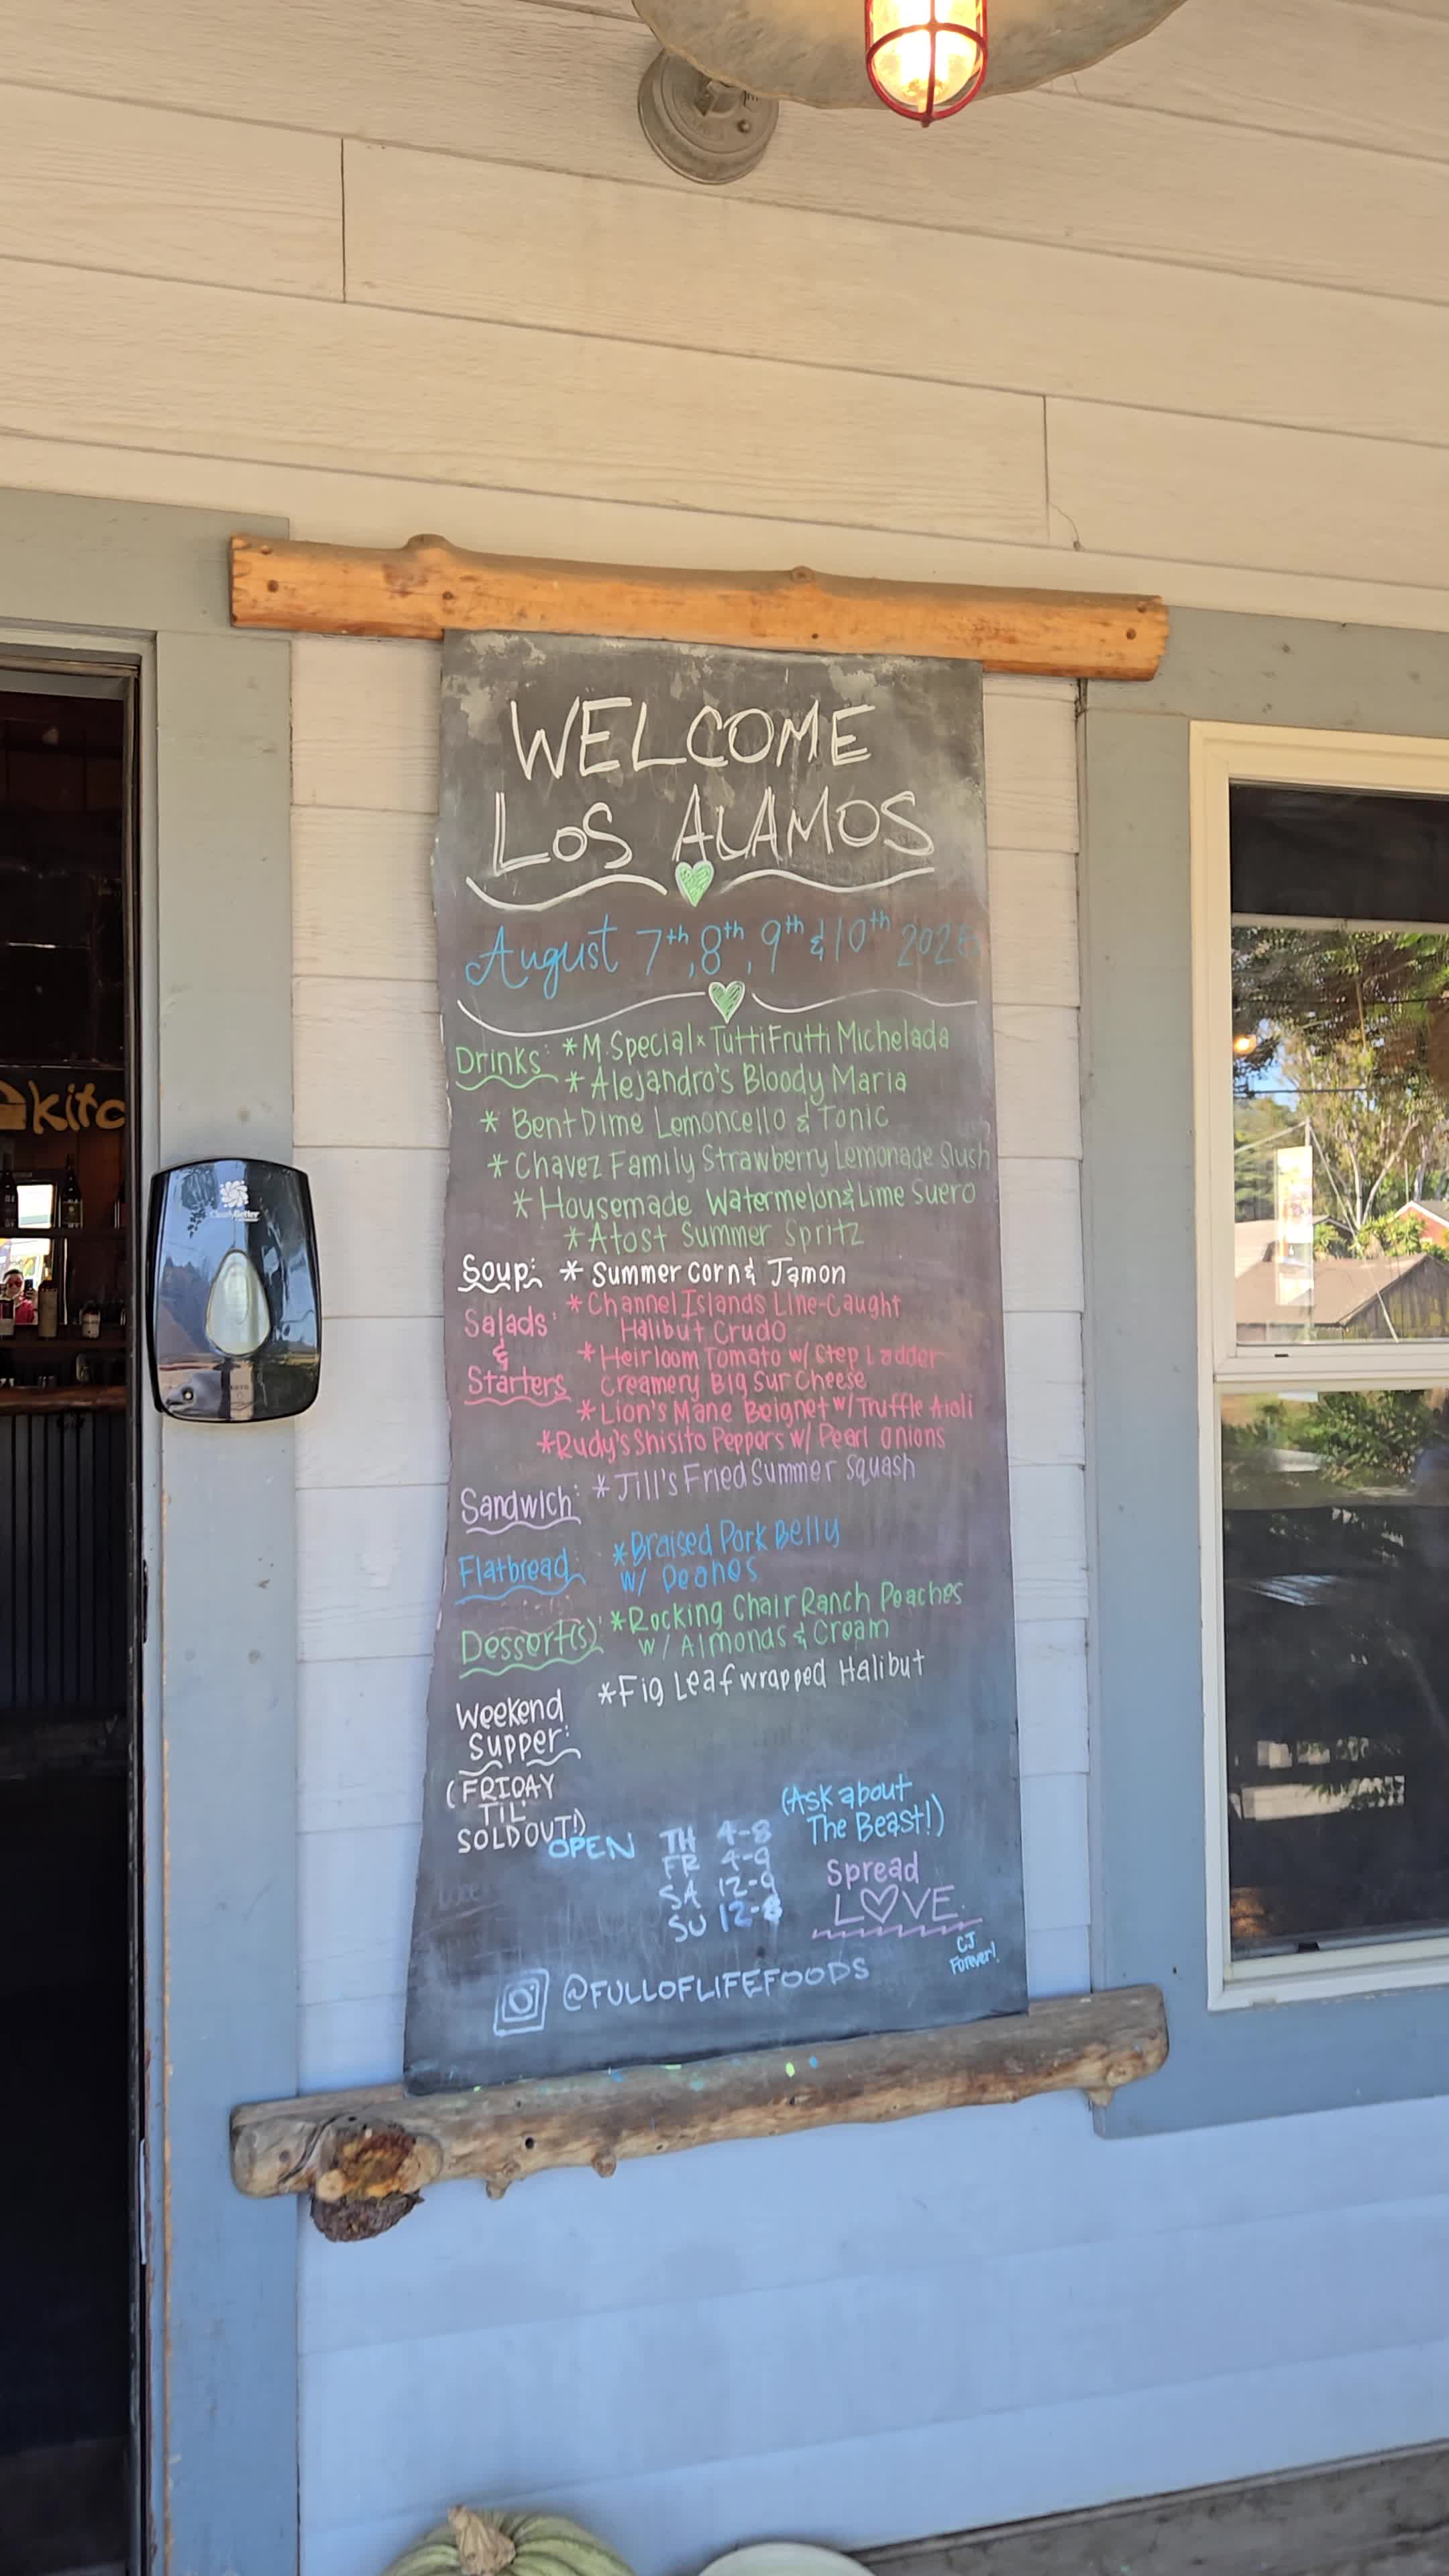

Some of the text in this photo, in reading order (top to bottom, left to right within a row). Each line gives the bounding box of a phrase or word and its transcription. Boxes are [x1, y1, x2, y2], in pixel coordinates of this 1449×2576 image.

[511, 696, 875, 780] WELCOME
[672, 784, 935, 863] ALAMOS
[465, 914, 619, 1000] August
[761, 915, 805, 975] 9th
[834, 910, 890, 963] 10th
[837, 1019, 949, 1055] Michelada
[591, 1063, 907, 1106] Alejandro's Bloody Maria
[513, 1107, 577, 1140] Bent
[655, 1106, 786, 1139] Lemoncello
[818, 1104, 889, 1131] Tonic
[515, 1150, 601, 1180] Chavez
[609, 1146, 695, 1183] Family
[703, 1143, 828, 1177] Strawberry
[835, 1140, 934, 1171] Lemonade
[540, 1186, 692, 1220] Housemade
[912, 1179, 976, 1205] Suero
[682, 1219, 771, 1249] Summer
[785, 1218, 864, 1254] Spritz
[592, 1261, 682, 1288] Summer
[767, 1257, 846, 1288] Jamon
[588, 1290, 676, 1317] Channel
[774, 1291, 902, 1319] Line-Caught
[621, 1316, 787, 1345] Halibut Crudo
[600, 1344, 698, 1371] Heirloom
[704, 1345, 782, 1370] Tomato
[789, 1342, 809, 1370] w/
[468, 1365, 567, 1397] Starters
[600, 1373, 700, 1402] Creamery
[712, 1372, 748, 1399] Big
[795, 1370, 867, 1391] Cheese
[600, 1399, 667, 1424] Lion's
[674, 1401, 735, 1426] Mane
[833, 1393, 853, 1417] w/
[855, 1393, 922, 1417] Truffle
[556, 1428, 631, 1464] Rudy's
[712, 1427, 784, 1456] Peppers
[790, 1421, 811, 1454] w/
[819, 1423, 868, 1450] Pearl
[614, 1468, 678, 1502] Jill's
[683, 1462, 747, 1493] Fried
[720, 1519, 767, 1555] Pork
[775, 1515, 841, 1550] Belly
[621, 1568, 647, 1597] w/
[629, 1601, 723, 1633] Rocking
[733, 1593, 796, 1621] Chair
[802, 1580, 870, 1617] Ranch
[639, 1633, 670, 1661] w/
[682, 1624, 786, 1659] Almonds
[814, 1618, 890, 1646] Cream
[618, 1648, 925, 1707] Fig Leaf wrapped Halibut
[456, 1688, 564, 1730] Weekend
[782, 1772, 912, 1816] (Ask about
[806, 1793, 945, 1845] The Beast!)
[548, 1832, 635, 1860] OPEN
[659, 1825, 696, 1854] TH
[662, 1854, 700, 1880] FR
[827, 1851, 919, 1887] Spread
[659, 1880, 701, 1910] SA
[669, 1914, 706, 1943] SU
